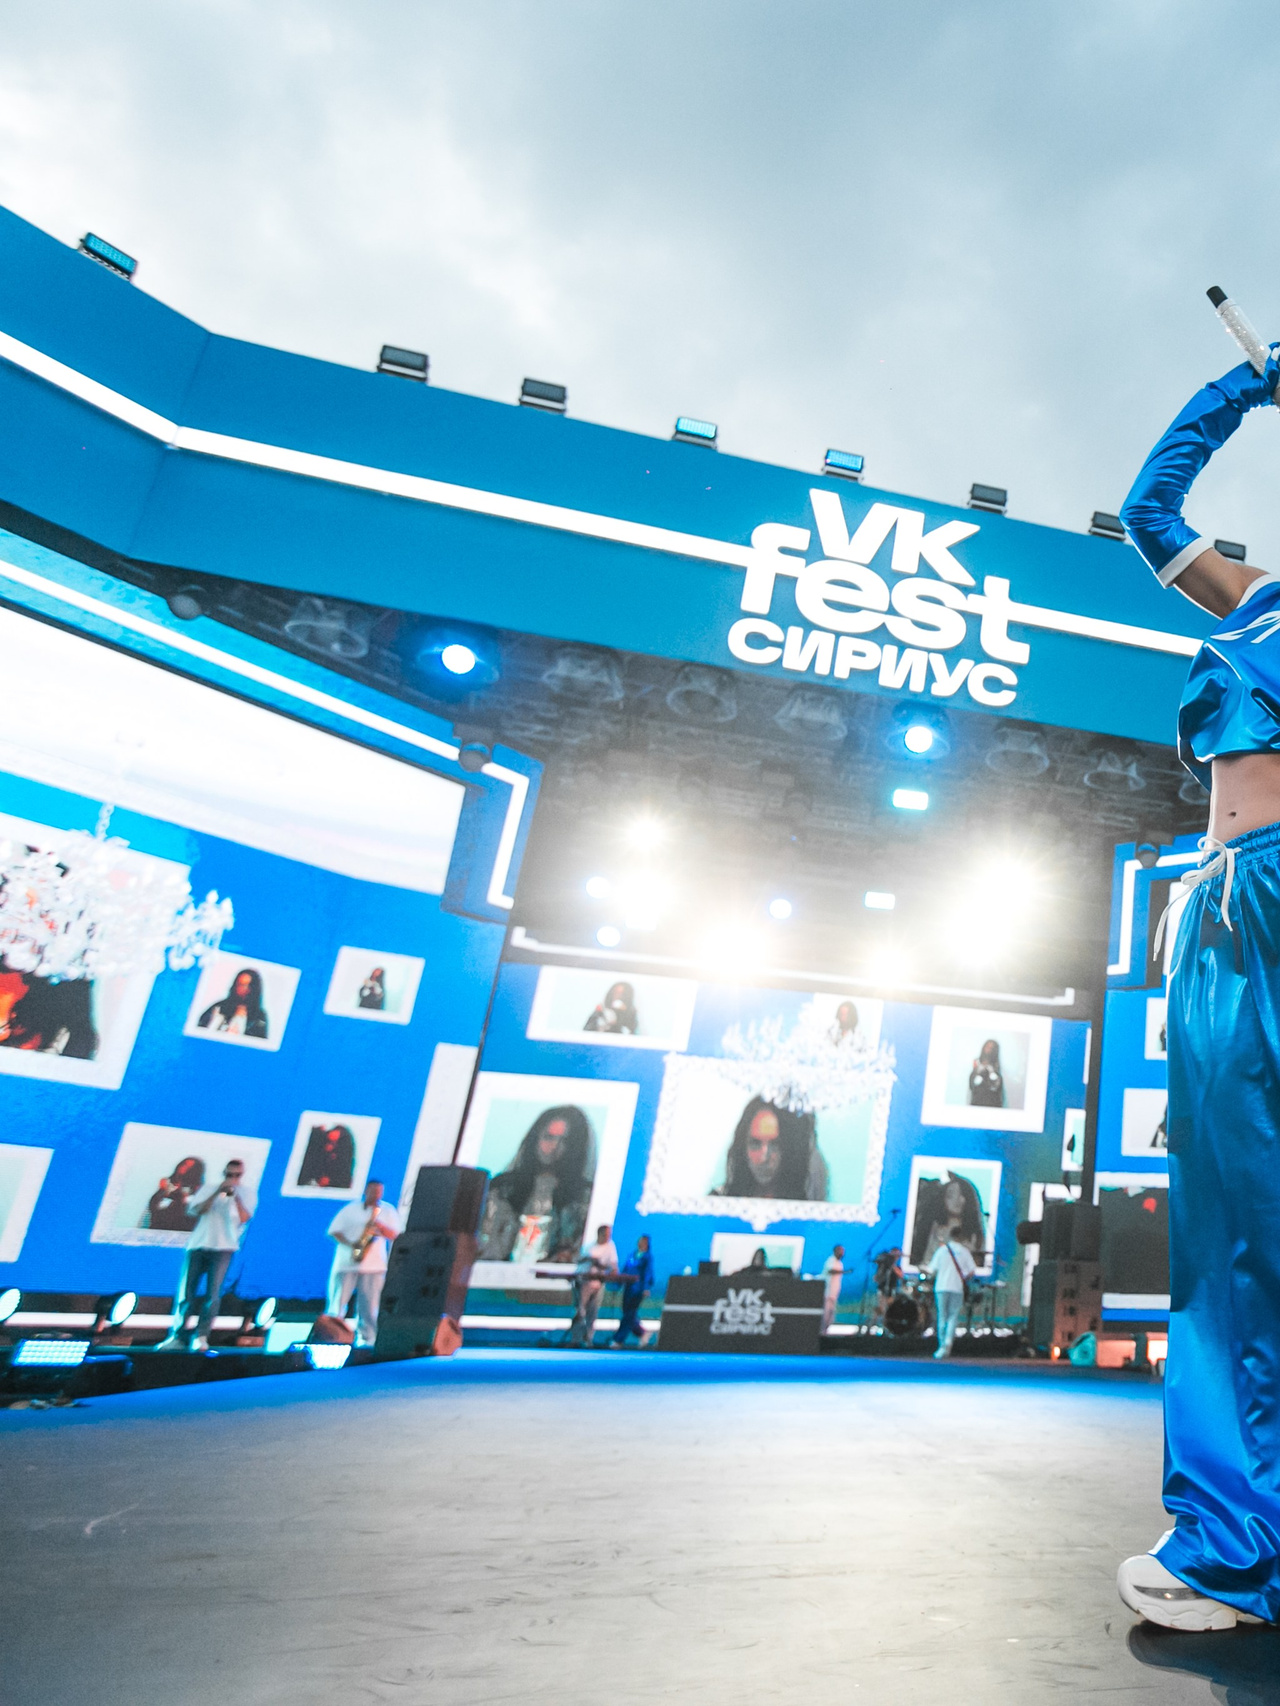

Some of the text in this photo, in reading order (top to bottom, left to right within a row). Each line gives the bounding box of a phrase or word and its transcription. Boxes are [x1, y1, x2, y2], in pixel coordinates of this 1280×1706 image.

[809, 488, 981, 586] VK
[740, 522, 1030, 665] fest
[727, 617, 1019, 707] СИРИУС
[713, 1299, 775, 1323] fest
[728, 1288, 765, 1304] VK
